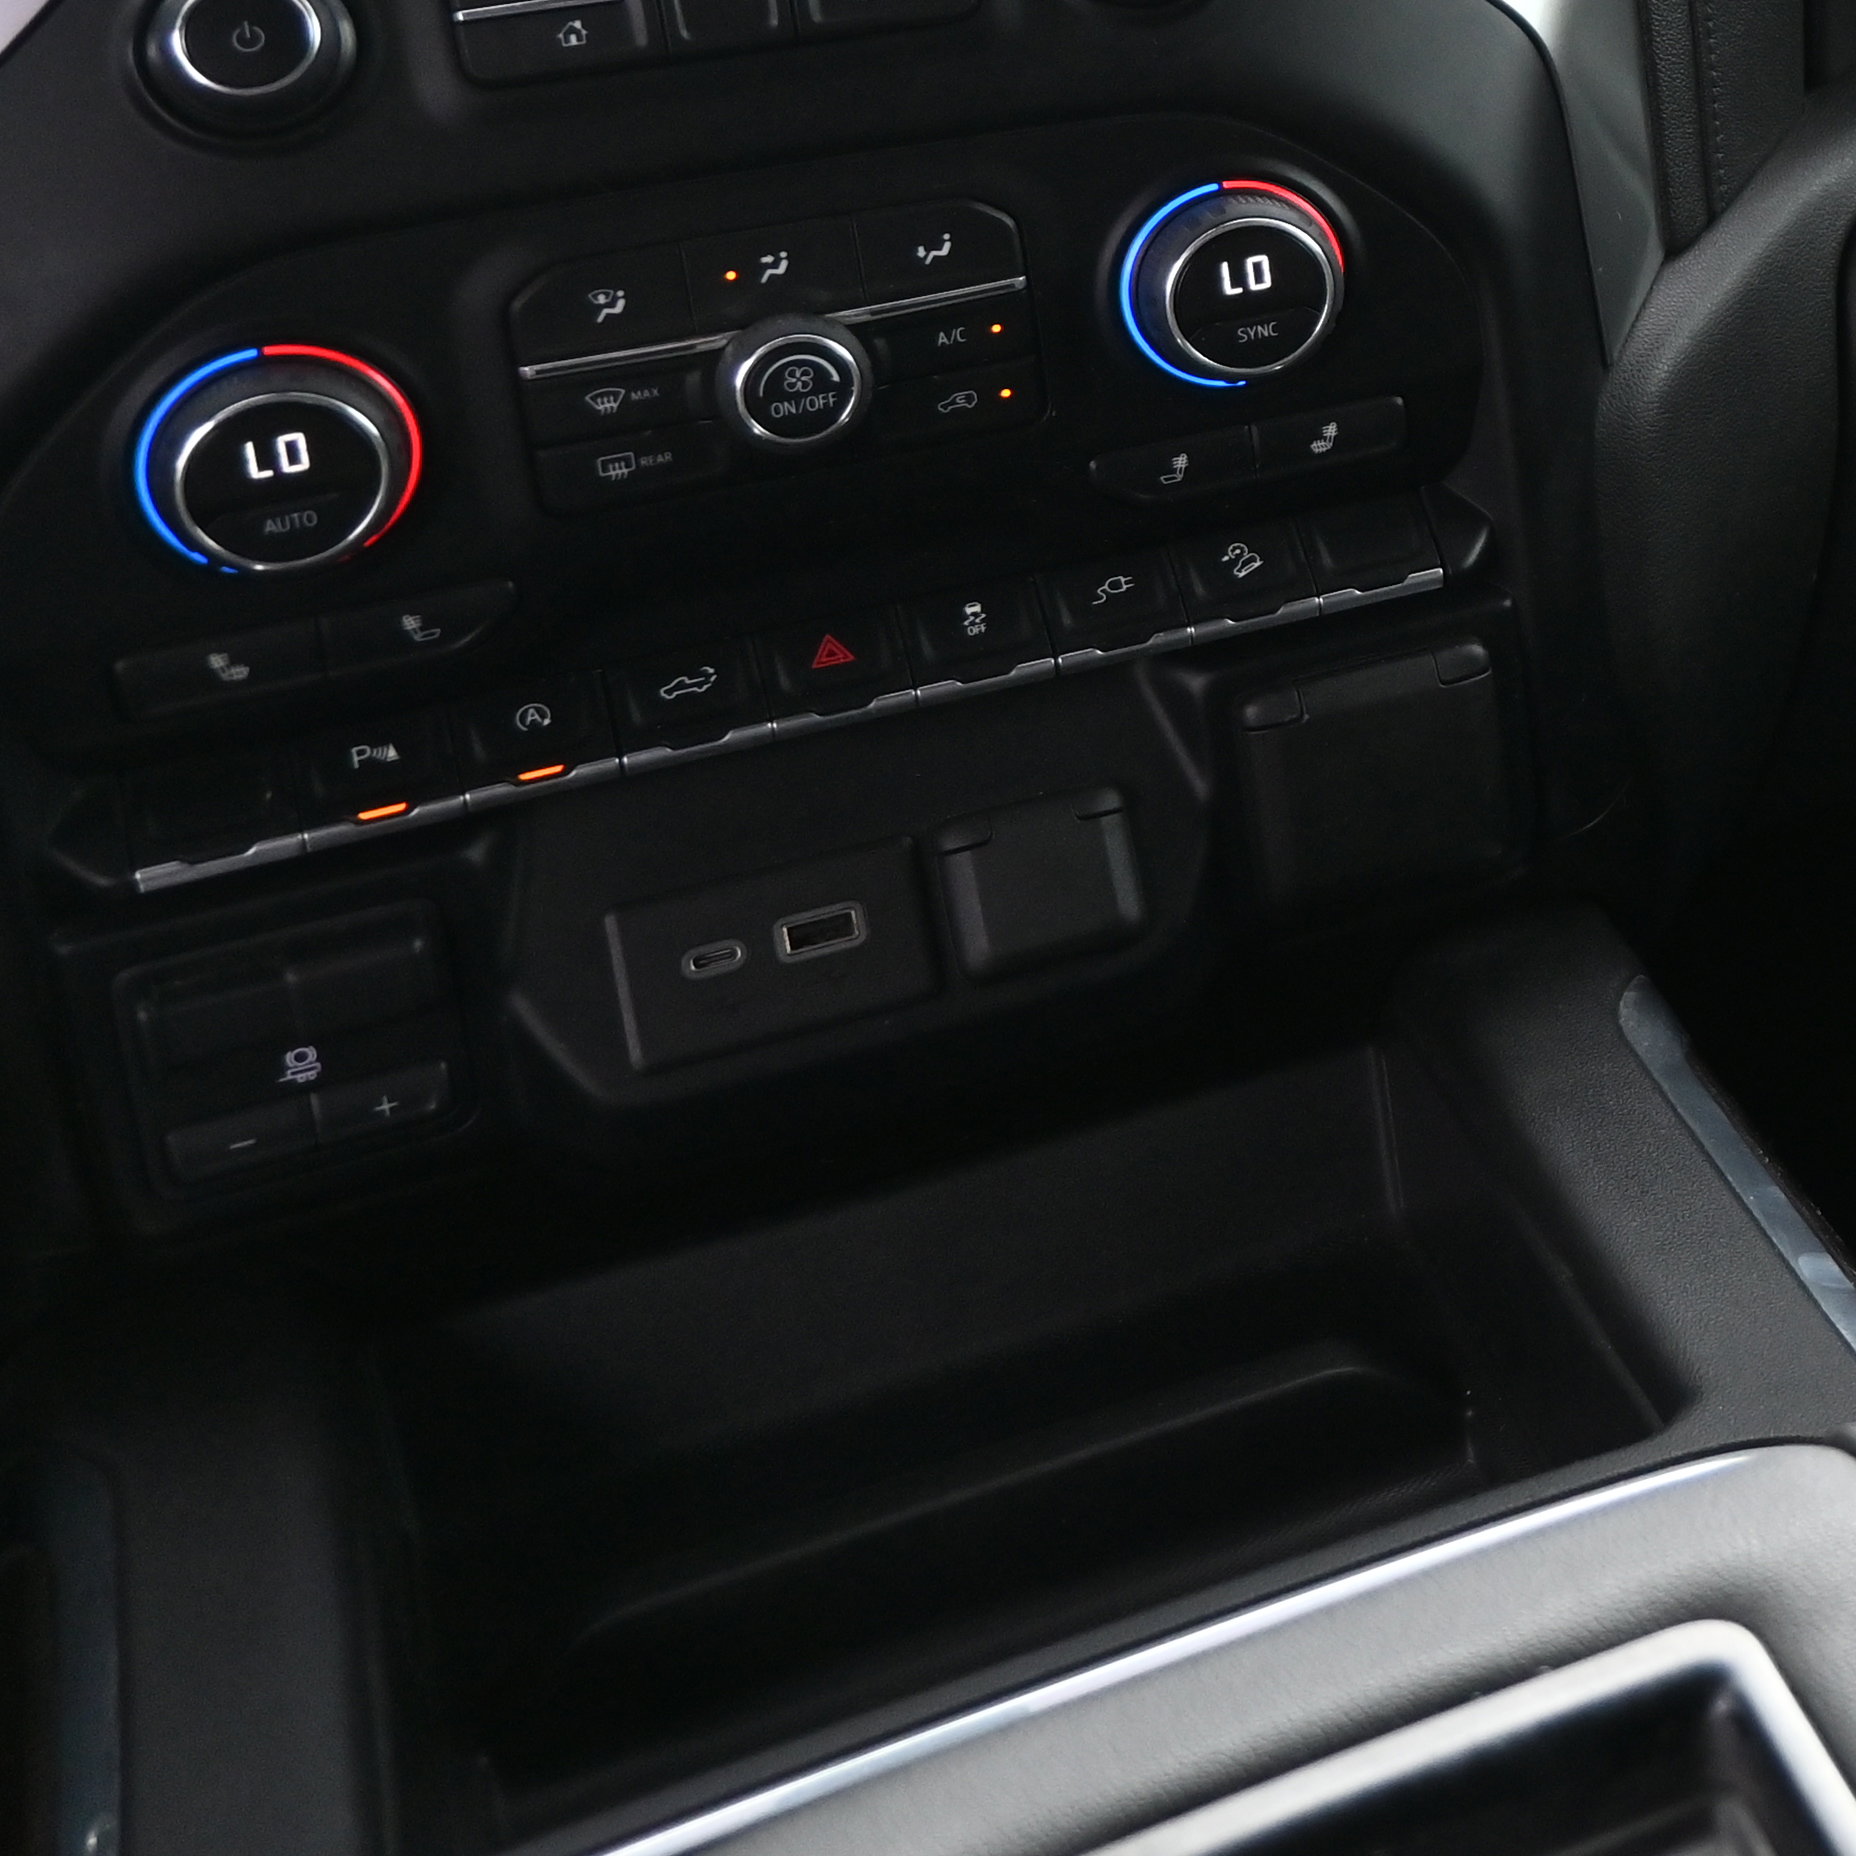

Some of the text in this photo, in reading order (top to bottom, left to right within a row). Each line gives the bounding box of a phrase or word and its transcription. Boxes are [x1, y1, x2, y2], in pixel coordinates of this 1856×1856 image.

[1221, 255, 1271, 295] LO
[938, 326, 967, 346] A/C
[1238, 322, 1277, 342] SYNC
[630, 387, 660, 401] MAX
[771, 391, 837, 418] ON/OFF
[244, 432, 310, 479] LO
[640, 451, 673, 466] REAR
[265, 511, 316, 532] AUTO
[967, 623, 986, 636] OFF
